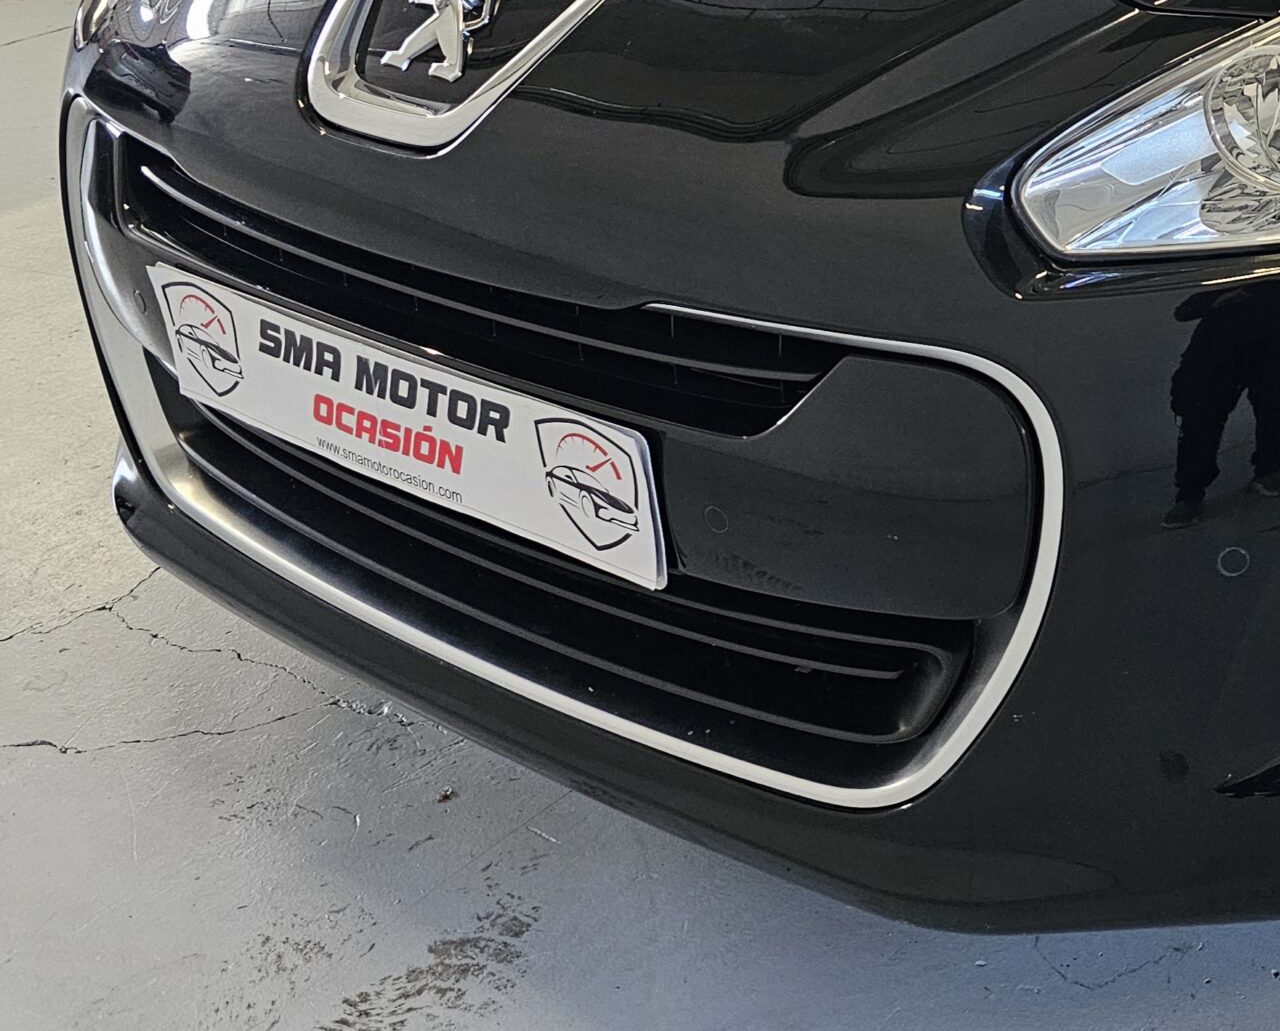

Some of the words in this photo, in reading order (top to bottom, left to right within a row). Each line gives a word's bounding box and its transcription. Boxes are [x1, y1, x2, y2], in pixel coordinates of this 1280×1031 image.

[259, 319, 341, 382] SMA
[354, 355, 510, 443] MOTOR
[313, 393, 464, 475] OCASIÓN
[316, 437, 463, 503] www.smamotorocasion.com
